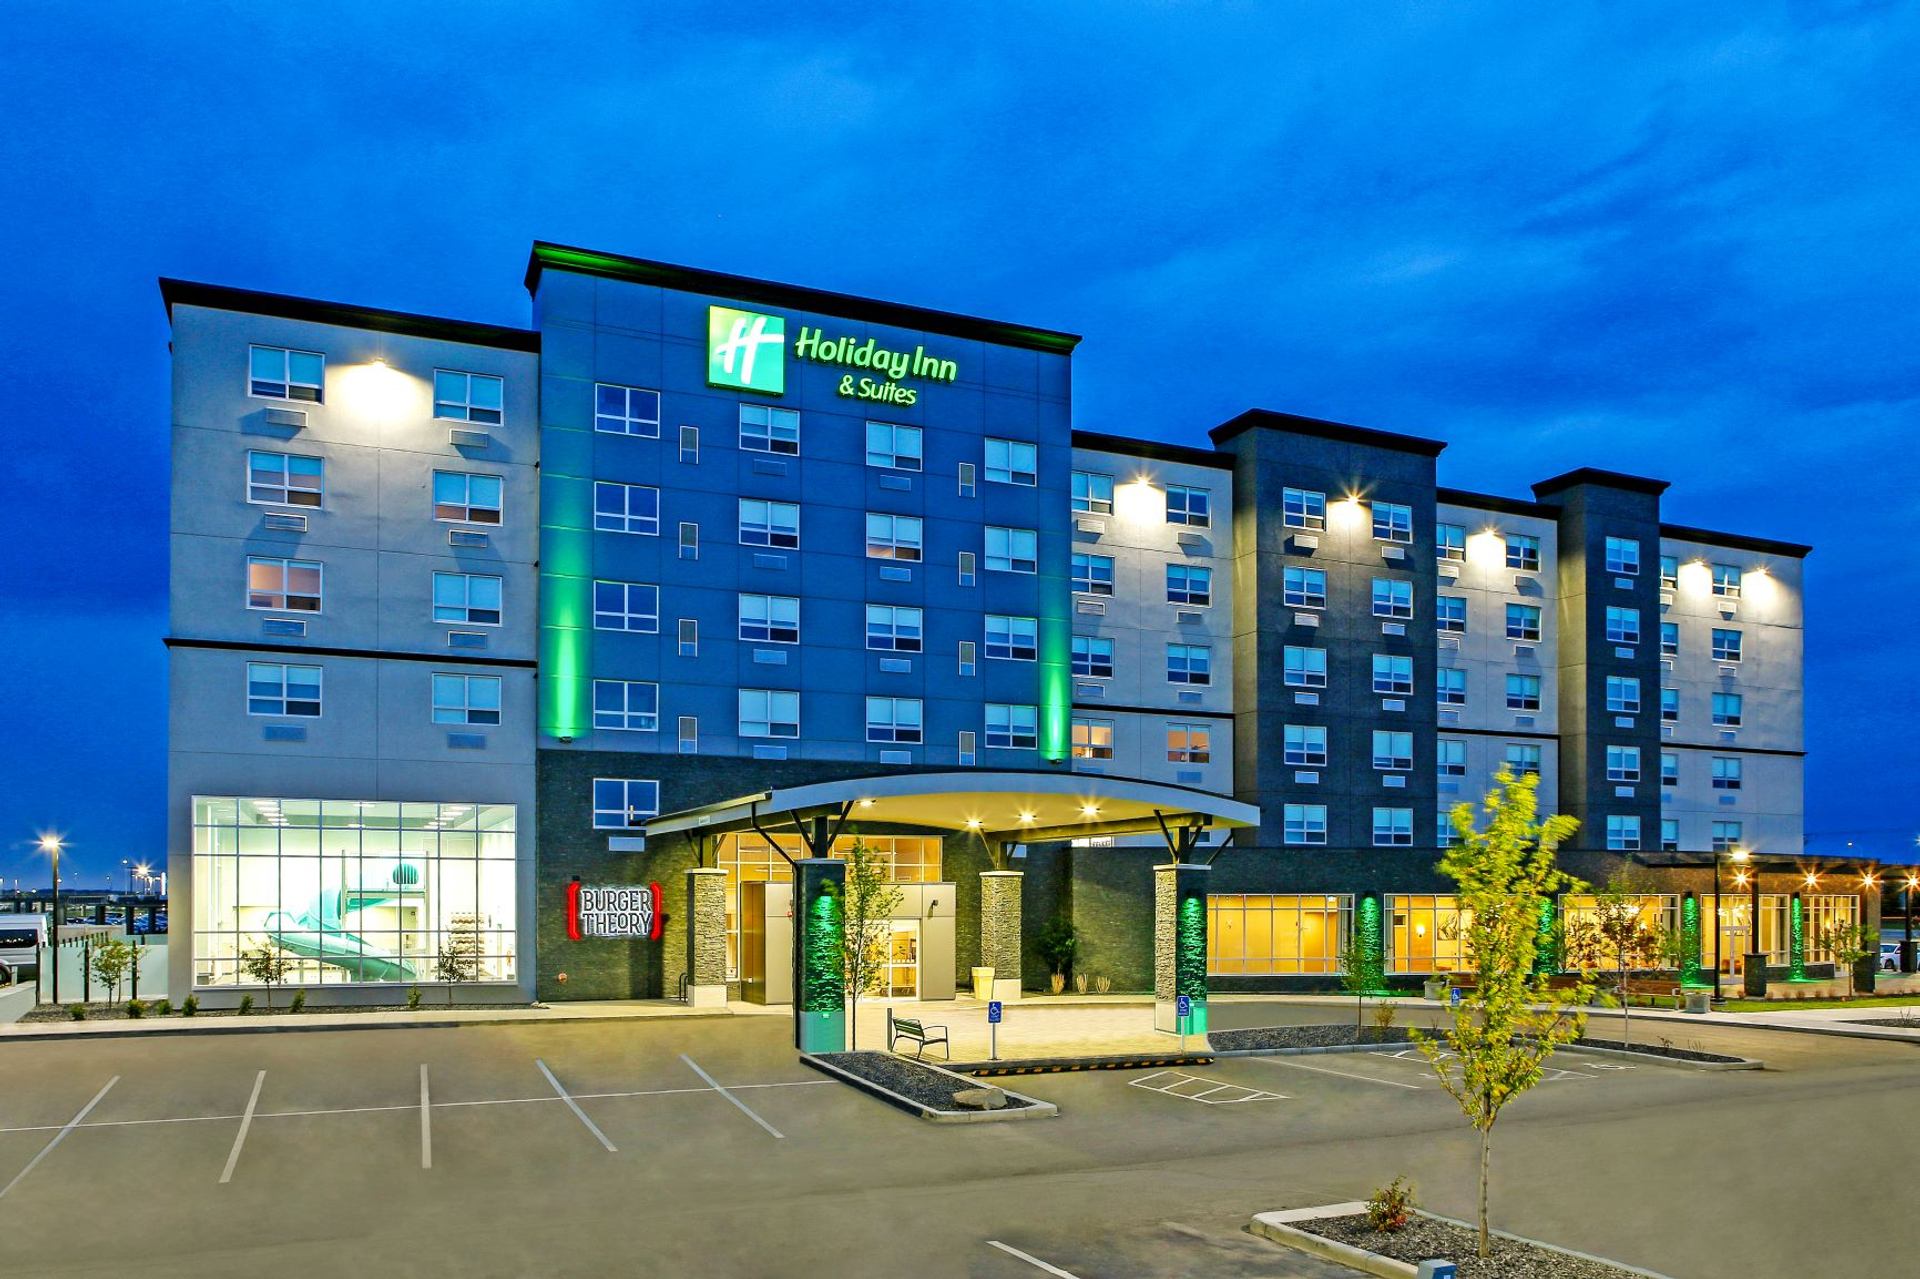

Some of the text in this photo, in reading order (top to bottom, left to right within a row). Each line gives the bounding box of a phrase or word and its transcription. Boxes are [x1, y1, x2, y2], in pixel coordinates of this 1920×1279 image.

[794, 326, 957, 381] Holiday Inn
[838, 374, 917, 405] & Suites
[582, 890, 652, 912] BURGER
[582, 912, 652, 934] THEORY
